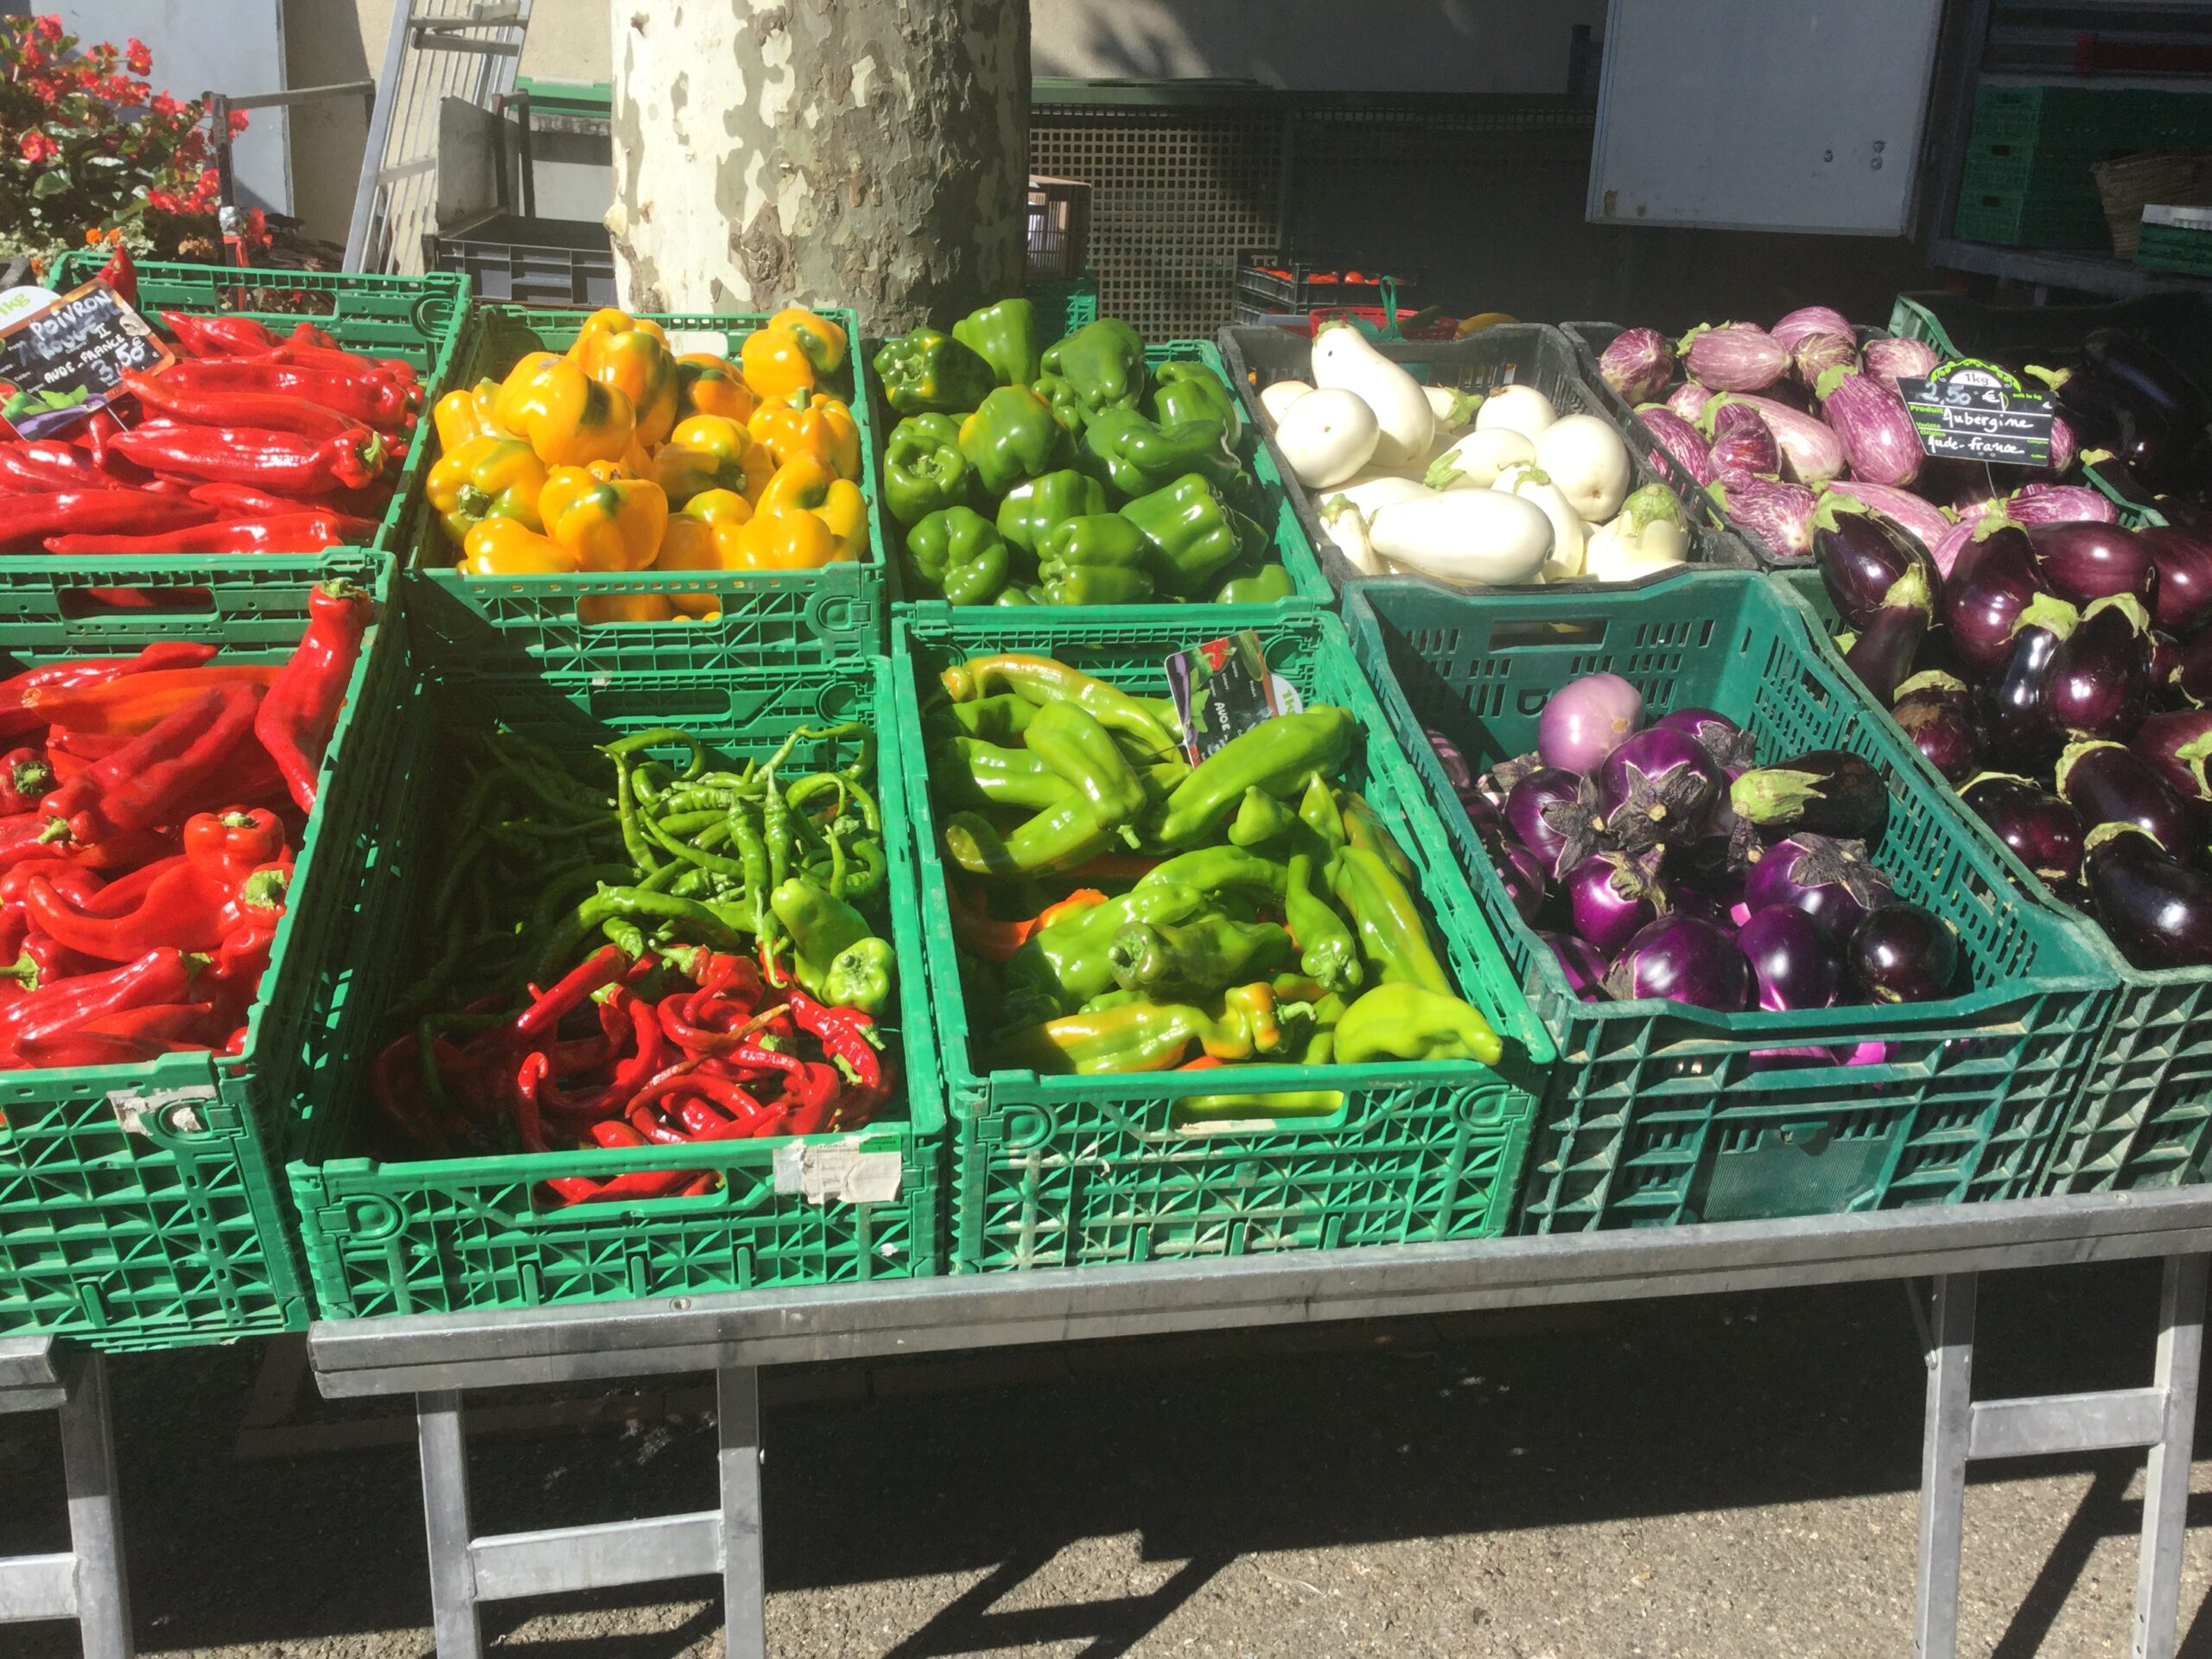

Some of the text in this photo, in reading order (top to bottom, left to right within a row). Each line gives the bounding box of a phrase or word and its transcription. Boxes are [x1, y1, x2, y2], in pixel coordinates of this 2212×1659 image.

[1964, 373, 1990, 386] 1kg
[1910, 404, 2034, 433] Produit Aubergine
